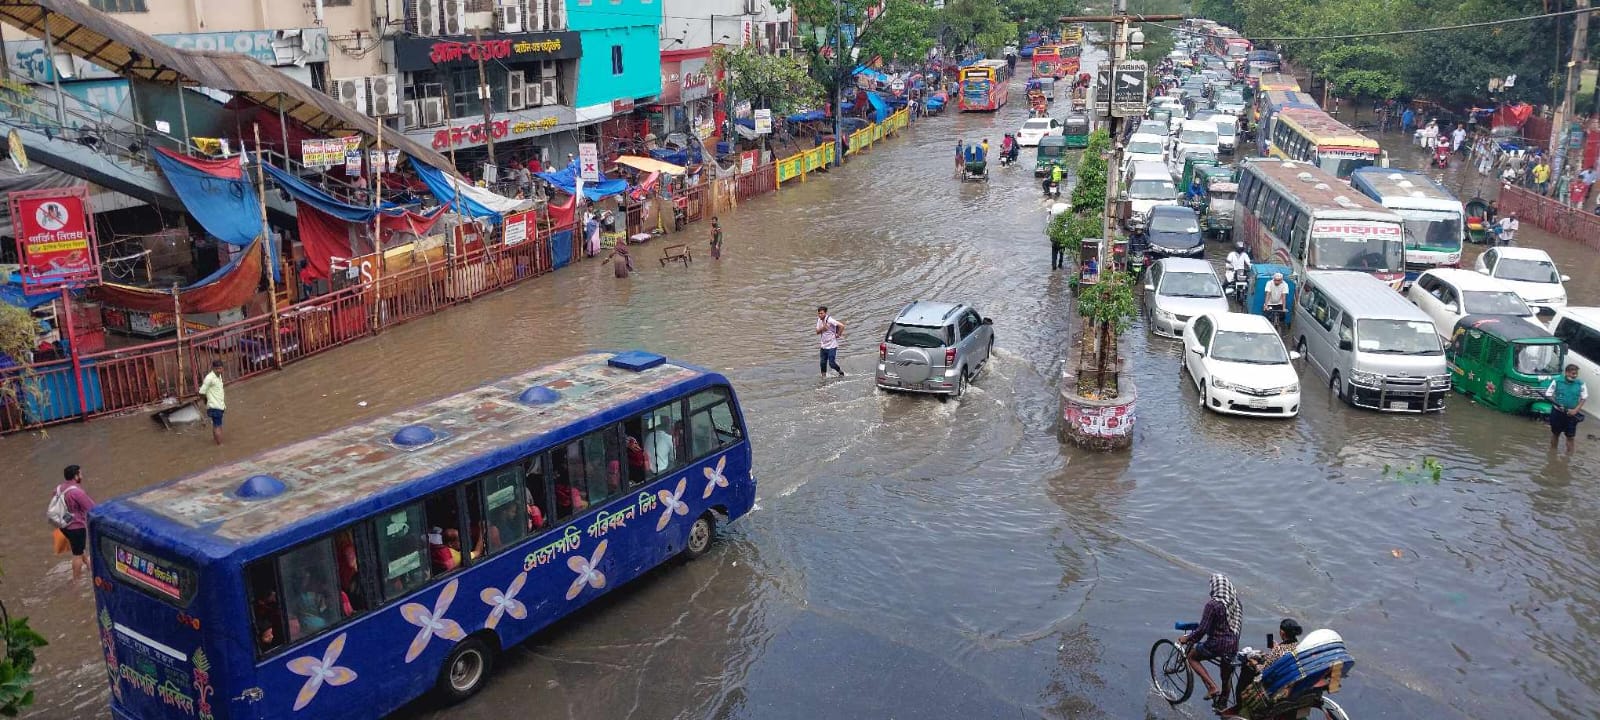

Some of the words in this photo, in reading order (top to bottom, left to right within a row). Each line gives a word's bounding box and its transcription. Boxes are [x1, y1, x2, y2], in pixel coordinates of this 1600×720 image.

[683, 72, 706, 89] Bata
[28, 232, 55, 243] পার্কিং
[56, 231, 83, 241] নিষেধ
[523, 526, 581, 572] প্রজাপতি
[587, 503, 635, 539] পরিবহন
[639, 491, 658, 516] লিঃ
